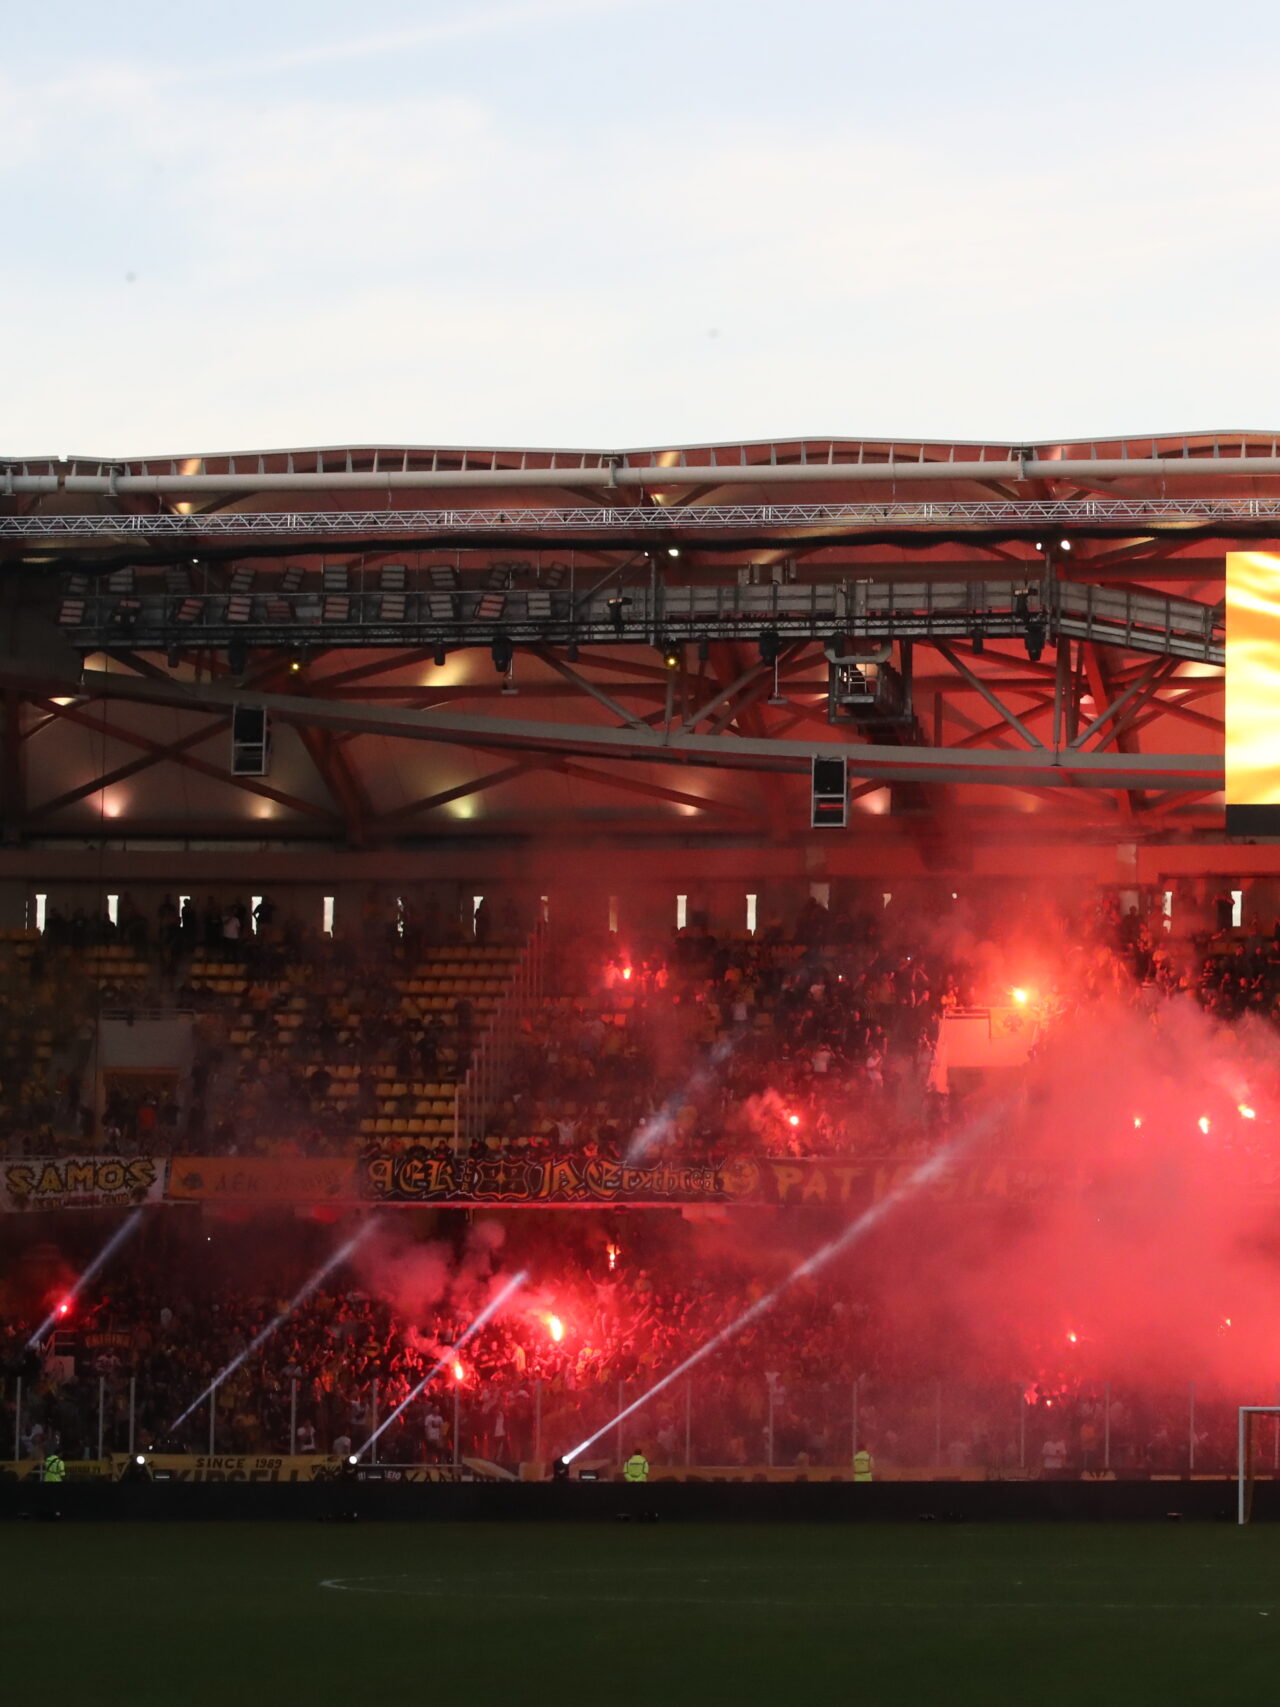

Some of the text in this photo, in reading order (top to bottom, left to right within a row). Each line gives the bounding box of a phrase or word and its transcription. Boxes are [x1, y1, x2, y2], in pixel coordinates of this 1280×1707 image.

[6, 1158, 157, 1195] SAMOS
[369, 1159, 457, 1192] AEK
[196, 1458, 282, 1469] SINCE 1989
